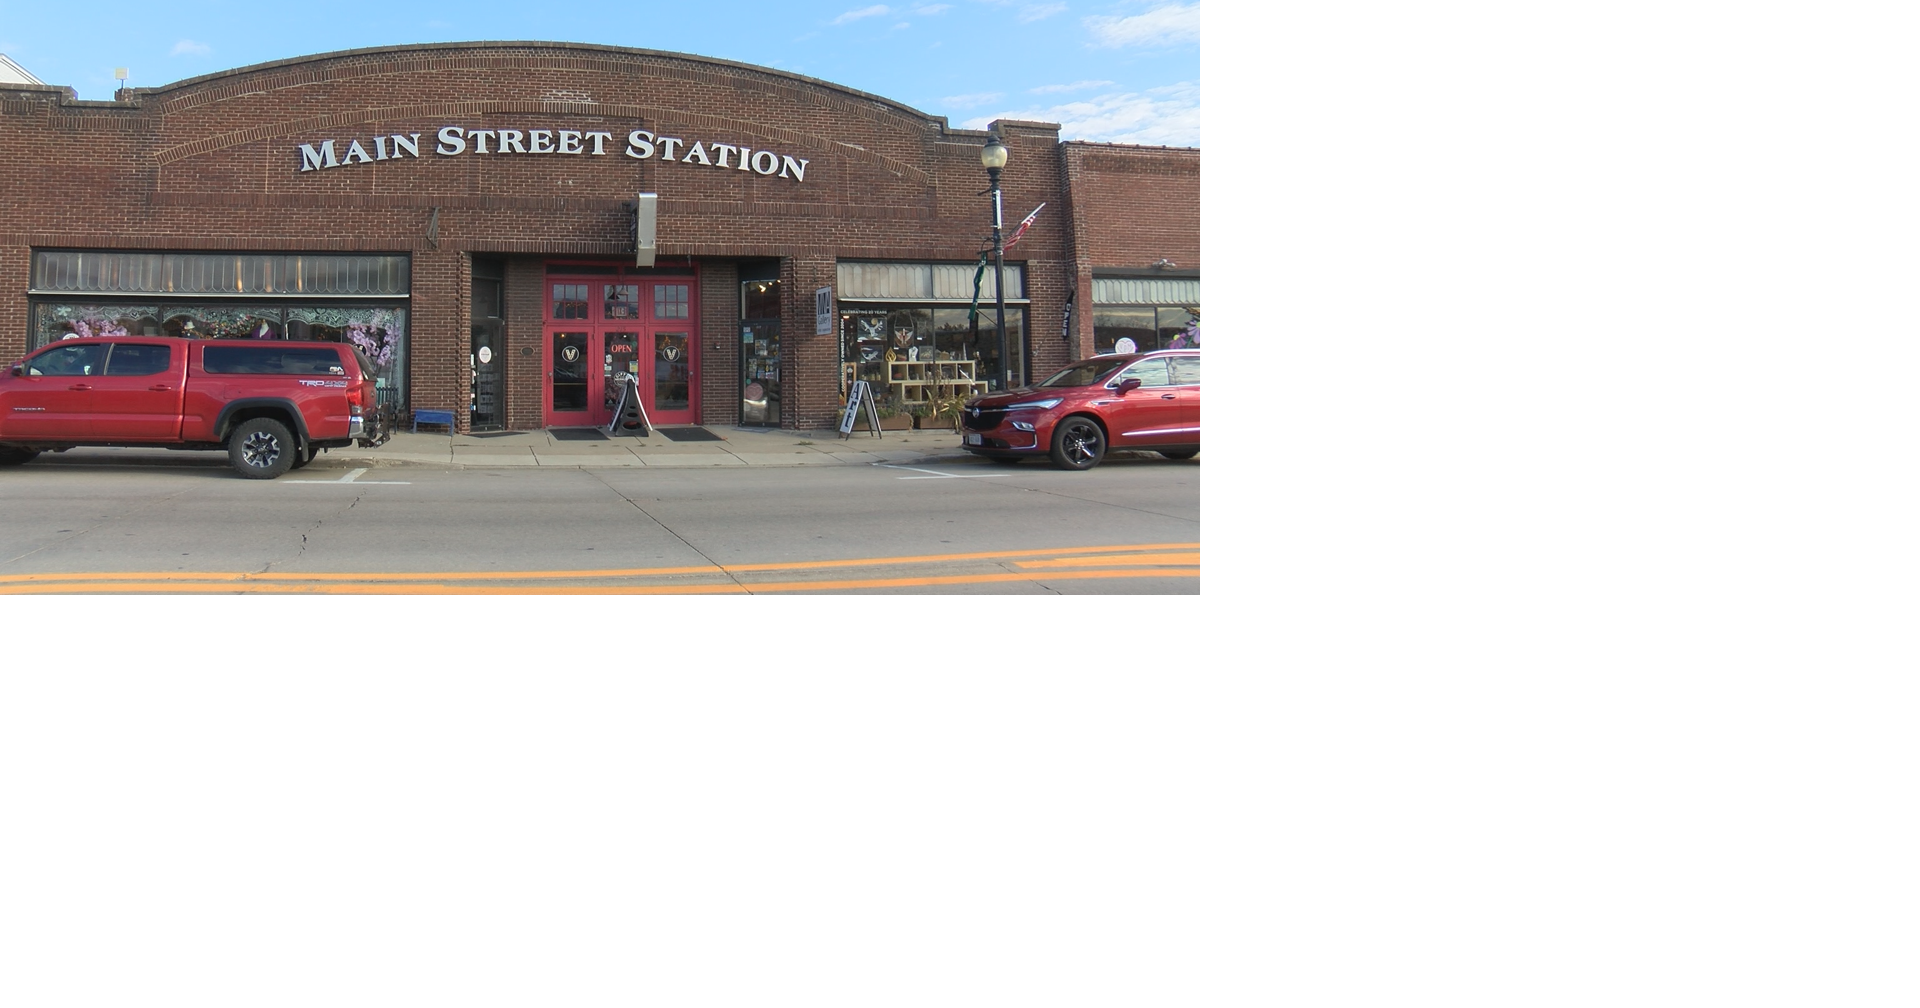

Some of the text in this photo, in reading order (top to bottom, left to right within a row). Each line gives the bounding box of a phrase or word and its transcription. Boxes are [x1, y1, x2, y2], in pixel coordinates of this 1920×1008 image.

[298, 126, 809, 182] MAIN STREET STATION
[1062, 303, 1071, 336] OPEN
[611, 344, 632, 353] OPEN
[844, 382, 860, 428] Art
